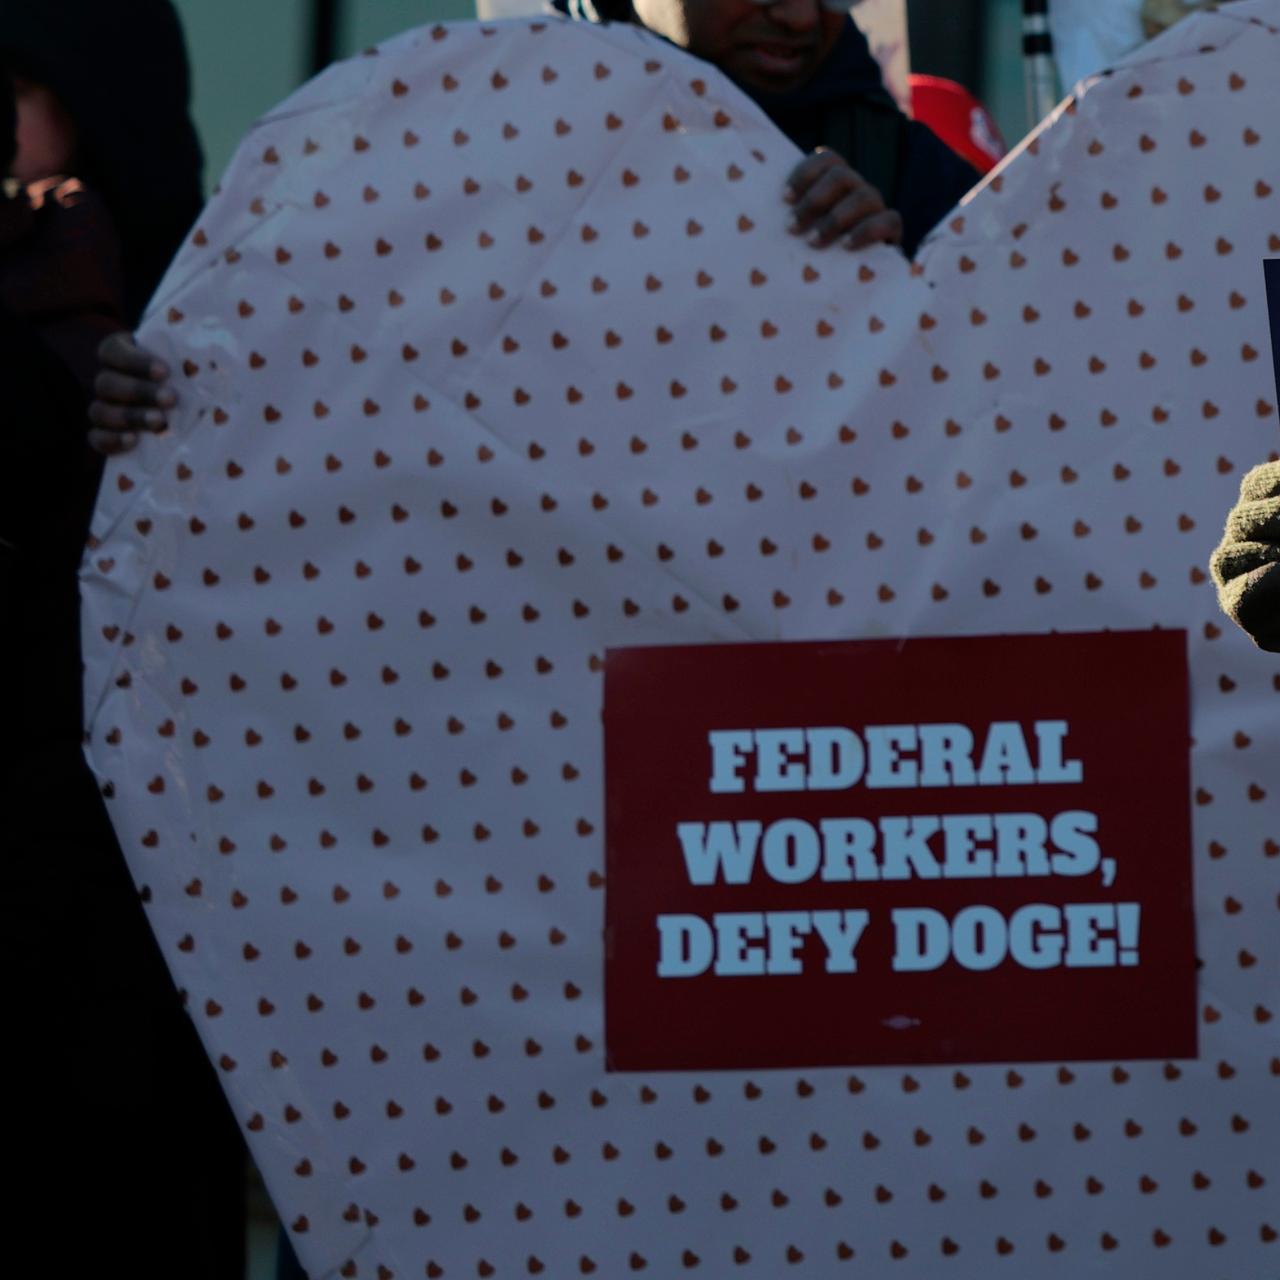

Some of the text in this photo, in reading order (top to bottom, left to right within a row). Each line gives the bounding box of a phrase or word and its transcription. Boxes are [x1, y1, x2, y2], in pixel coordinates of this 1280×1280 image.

[709, 720, 1083, 794] FEDERAL
[677, 810, 1117, 886] WORKERS,
[656, 902, 1140, 978] DEFY DOGE!
